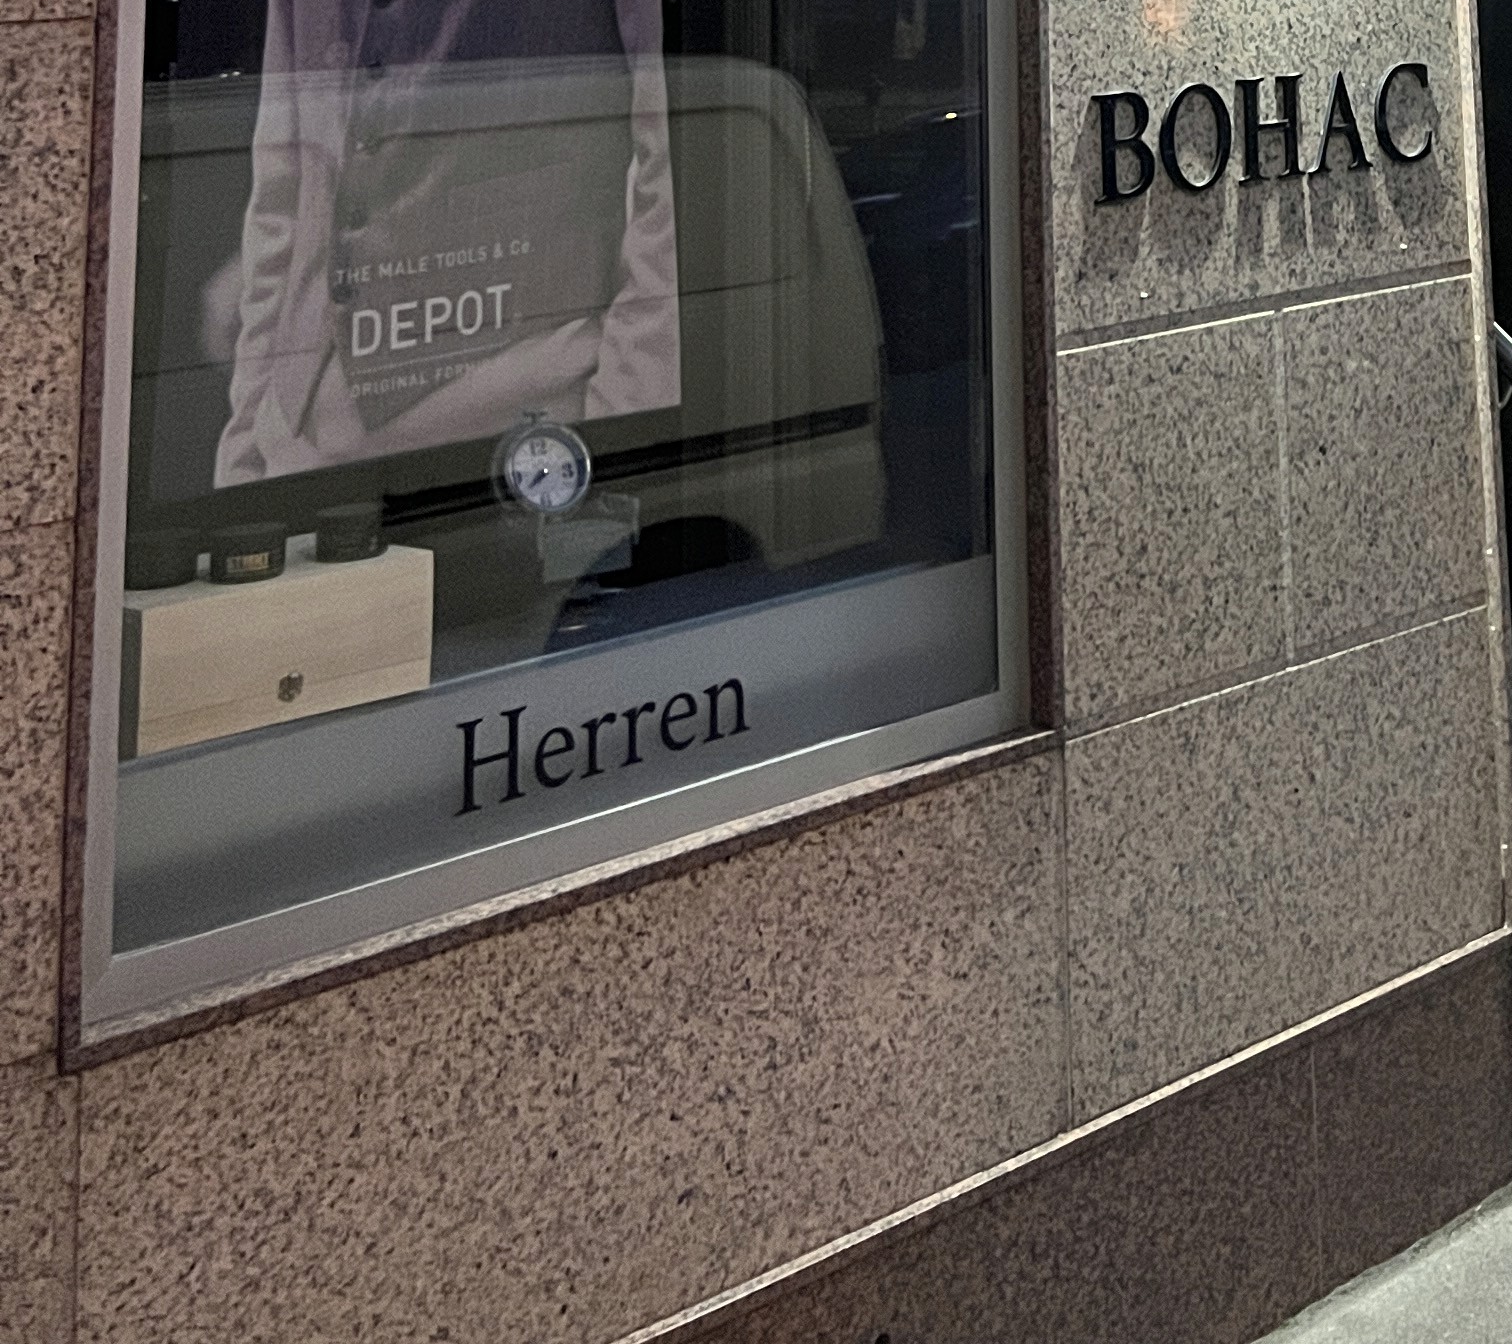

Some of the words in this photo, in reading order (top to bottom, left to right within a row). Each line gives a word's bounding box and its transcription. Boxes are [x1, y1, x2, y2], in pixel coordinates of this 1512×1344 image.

[1090, 61, 1433, 206] BOHAC
[335, 264, 372, 286] THE
[378, 255, 429, 279] MALE
[435, 245, 489, 270] TOOLS
[351, 282, 513, 358] DEPOT
[455, 675, 751, 817] Herren
